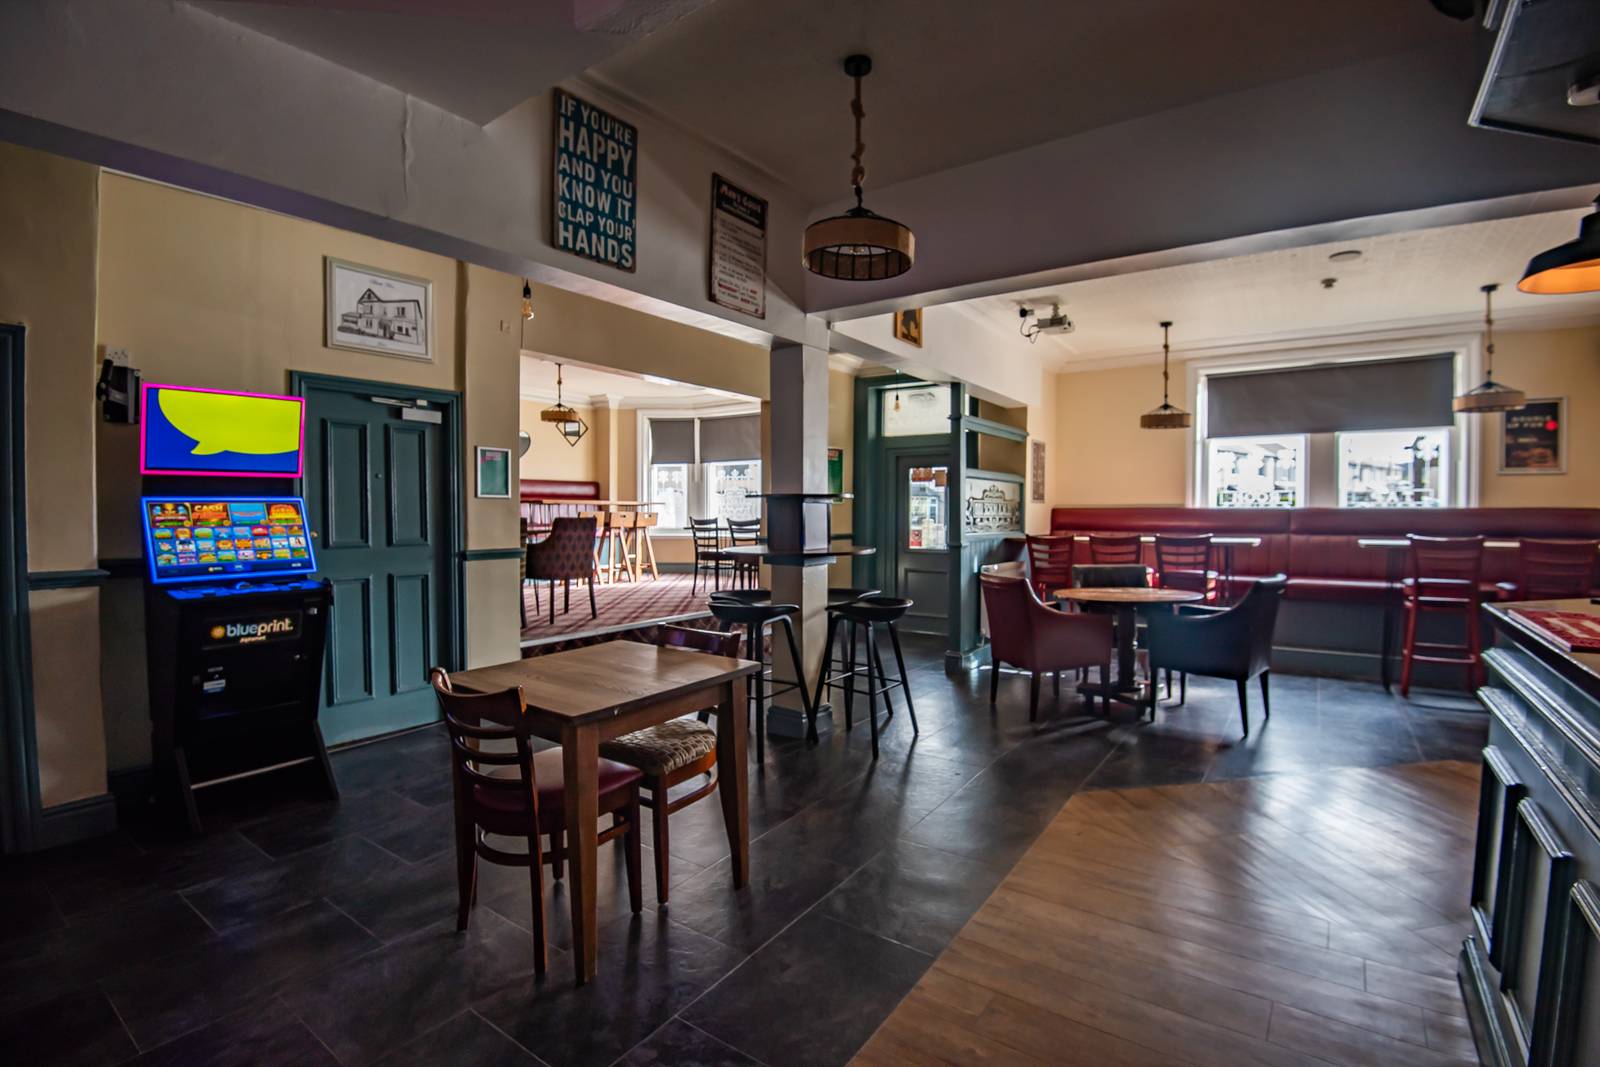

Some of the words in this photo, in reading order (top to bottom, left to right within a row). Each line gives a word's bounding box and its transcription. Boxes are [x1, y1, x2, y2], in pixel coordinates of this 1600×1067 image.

[560, 95, 577, 117] IF
[581, 105, 632, 146] YOU'RE
[560, 116, 633, 177] HAPPY
[559, 153, 596, 183] AND
[600, 169, 632, 199] YOU
[559, 173, 612, 214] KNOW
[558, 201, 594, 227] CLAP
[598, 215, 632, 242] YOUR
[559, 221, 633, 268] HANDS
